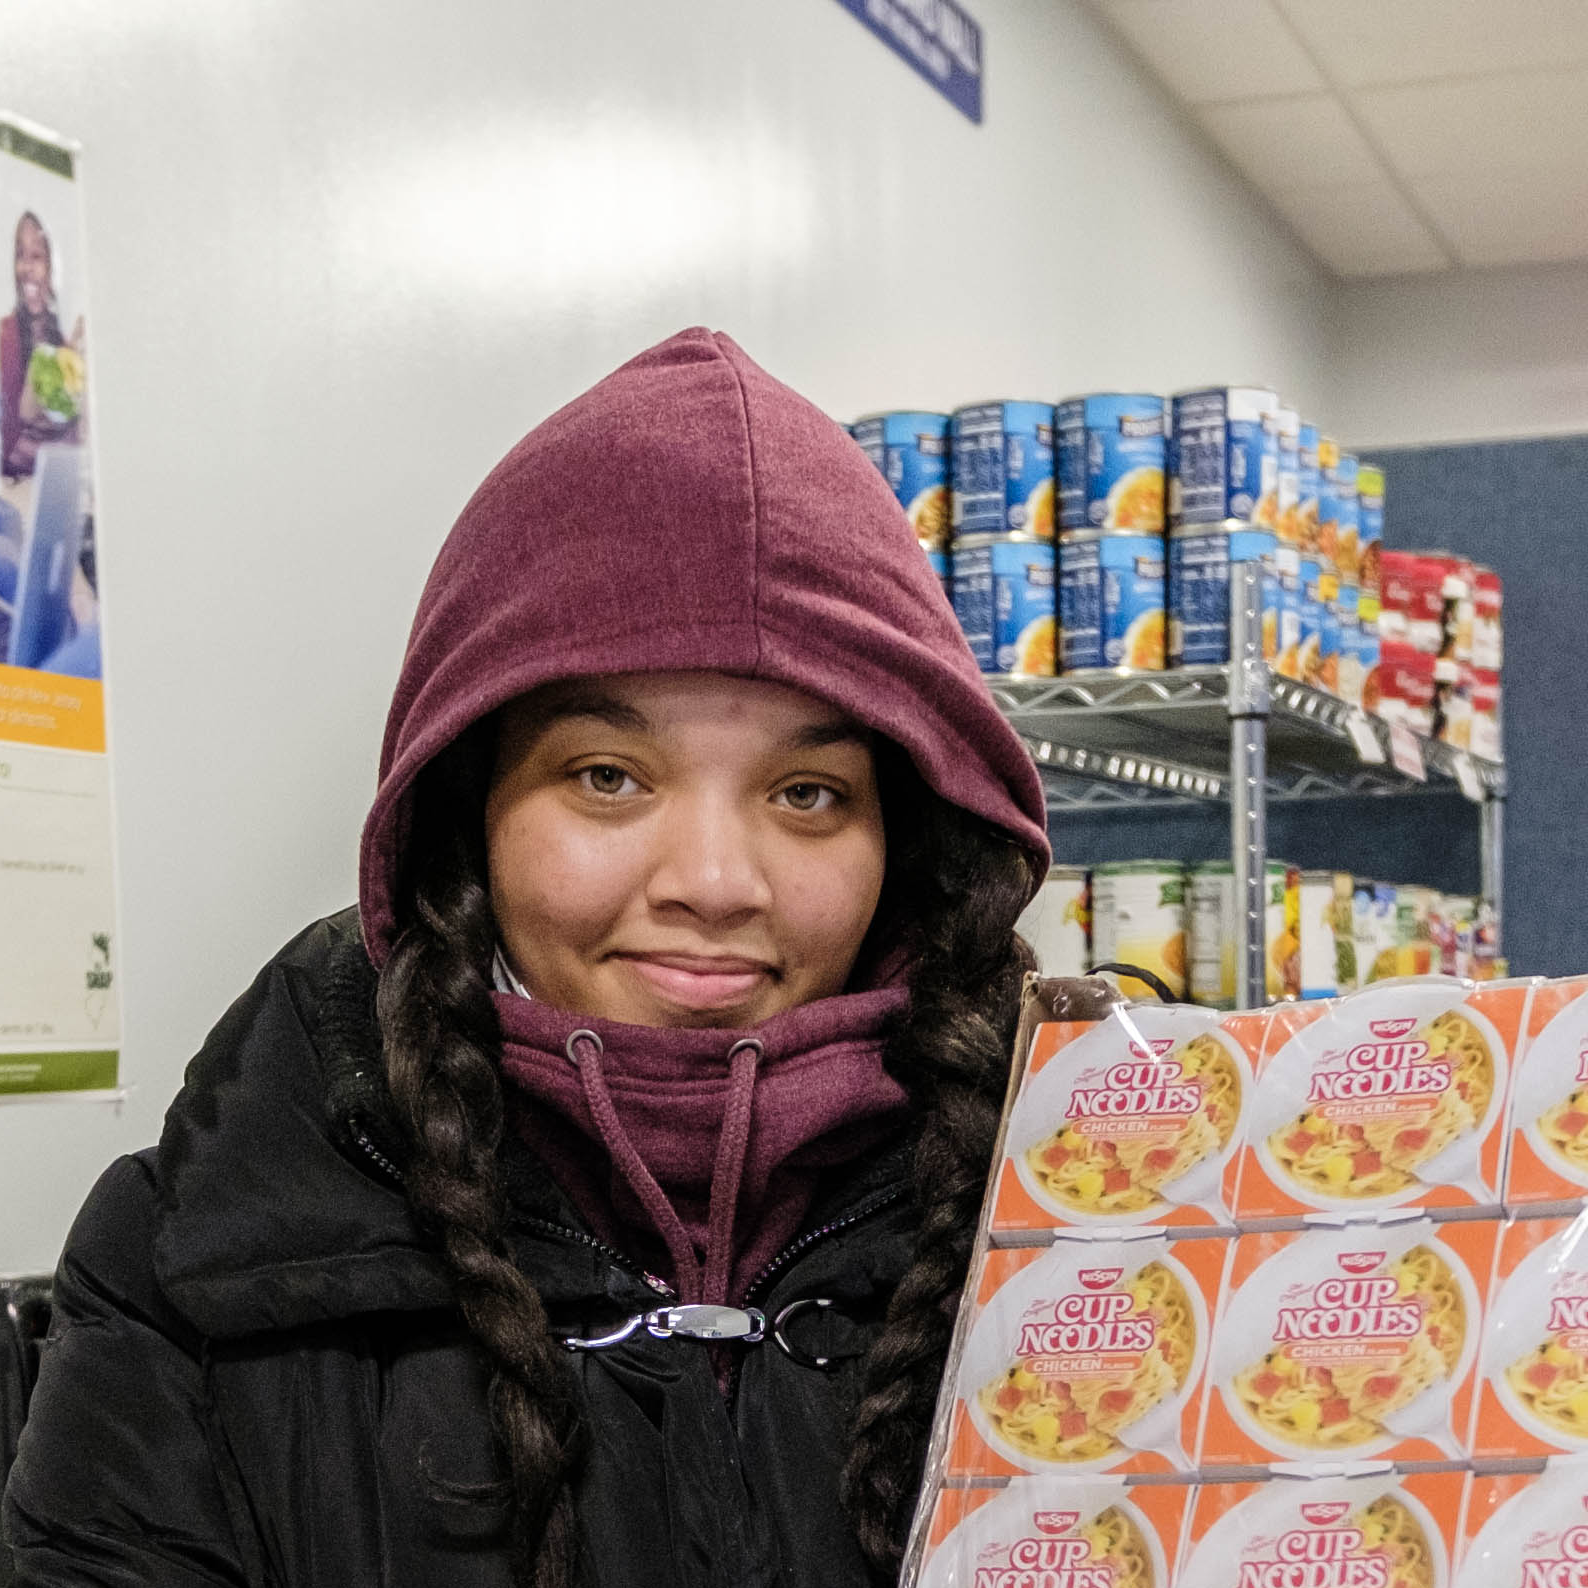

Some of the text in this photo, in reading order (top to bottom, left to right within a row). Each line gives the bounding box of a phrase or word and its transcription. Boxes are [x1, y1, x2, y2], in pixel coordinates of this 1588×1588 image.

[1372, 1021, 1412, 1033] NISSIN
[1347, 1041, 1428, 1071] CUP
[1105, 1062, 1182, 1089] CUP
[1307, 1063, 1451, 1102] NOODLES
[1065, 1084, 1201, 1118] NOODLES
[1324, 1103, 1397, 1116] CHICKEN
[1081, 1120, 1148, 1133] CHICKEN
[1081, 1271, 1119, 1283] NISSIN
[1315, 1277, 1398, 1309] CUP
[1055, 1294, 1134, 1324] CUP
[1273, 1303, 1421, 1340] NOODLES
[1017, 1319, 1154, 1355] NOODLES
[1292, 1345, 1367, 1358] CHICKEN
[1033, 1359, 1102, 1371] CHICKEN
[1036, 1513, 1076, 1527] NISSIN
[1010, 1538, 1091, 1570] CUP
[1277, 1528, 1364, 1561] CUP
